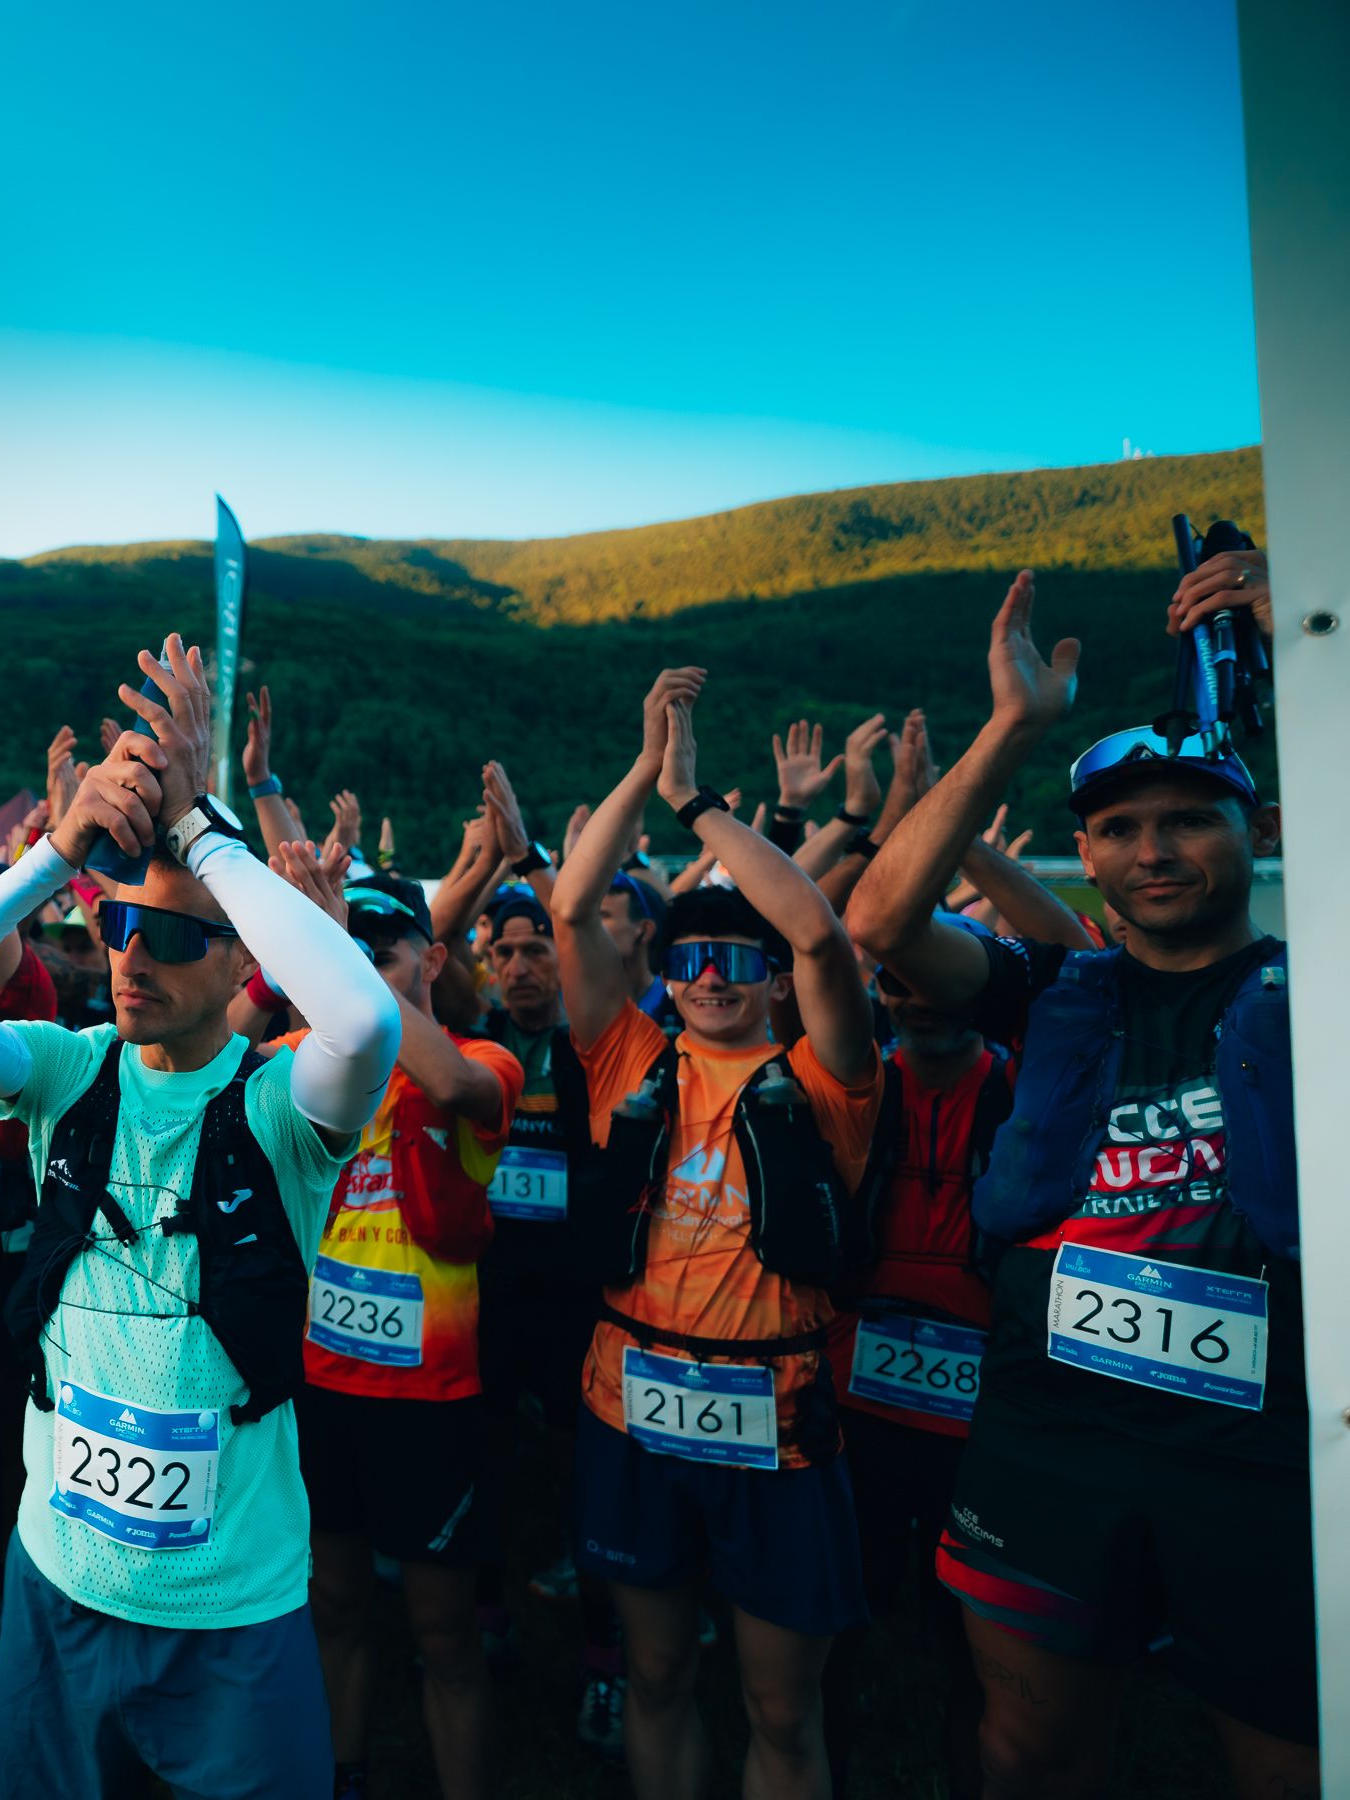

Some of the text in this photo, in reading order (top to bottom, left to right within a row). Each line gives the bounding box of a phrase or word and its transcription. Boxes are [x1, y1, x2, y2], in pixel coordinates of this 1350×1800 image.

[488, 1170, 546, 1200] 131
[1053, 1280, 1064, 1329] MARATHON
[1127, 1273, 1173, 1289] GARMIN
[321, 1290, 404, 1339] 2236
[1072, 1290, 1230, 1364] 2316
[874, 1343, 977, 1394] 2268
[1091, 1355, 1134, 1372] GARMIN
[109, 1419, 145, 1434] GARMIN
[644, 1388, 742, 1436] 2161
[70, 1437, 191, 1511] 2322
[86, 1509, 115, 1528] GARMIN
